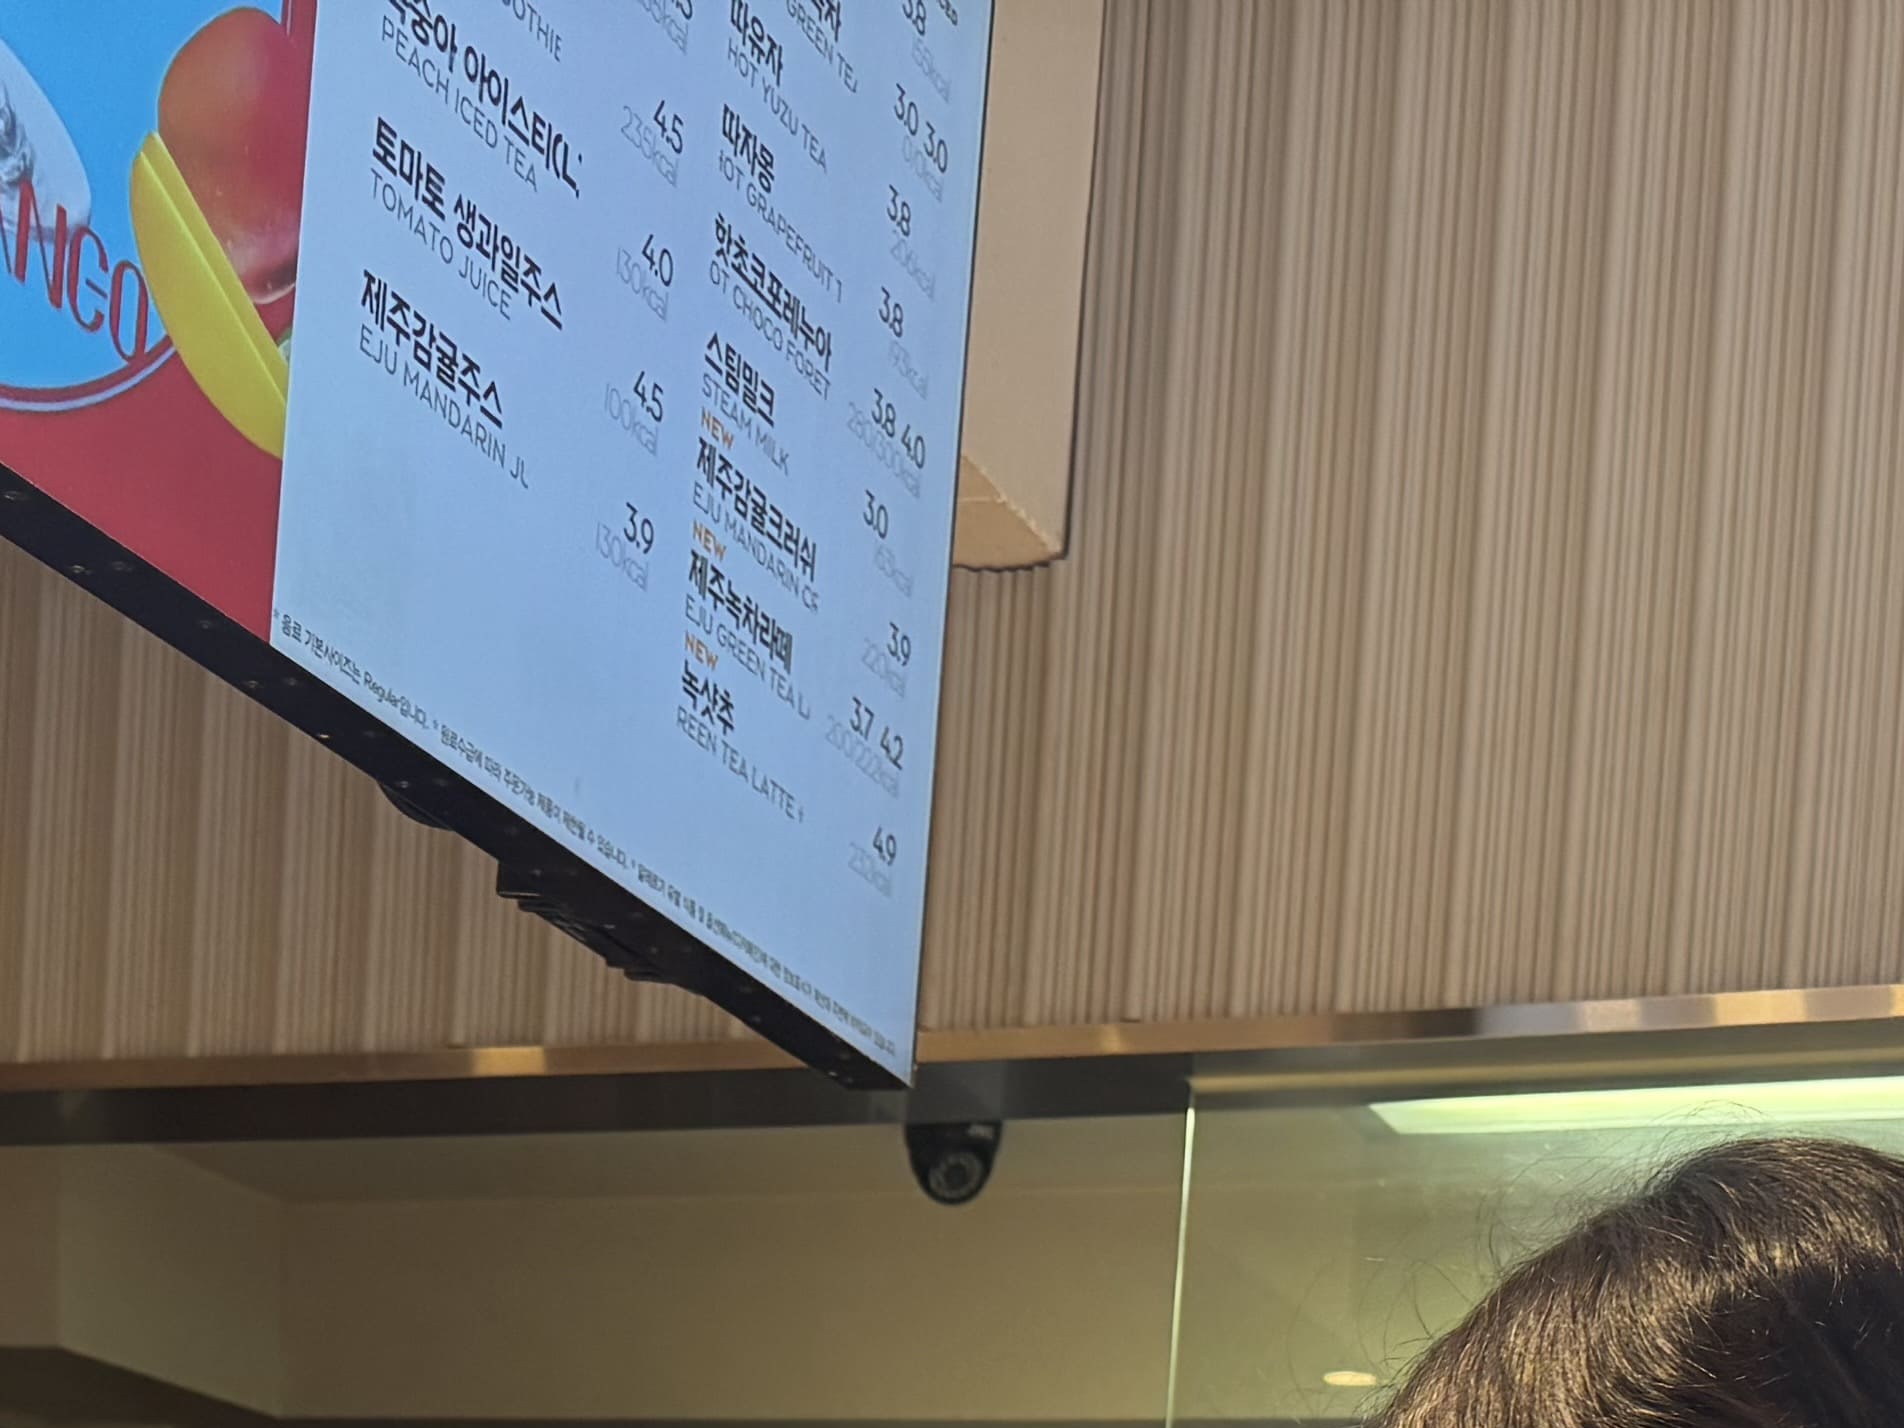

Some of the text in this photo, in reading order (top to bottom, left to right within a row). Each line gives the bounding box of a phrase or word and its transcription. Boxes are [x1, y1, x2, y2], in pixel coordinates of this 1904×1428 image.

[381, 14, 539, 193] PEACH ICED TEA
[652, 99, 685, 154] 4.5
[727, 37, 828, 173] HOT YUZU TEA
[894, 83, 949, 175] 3.0 3.0
[370, 167, 512, 320] TOMATO JUICE
[372, 116, 563, 330] 토마토 생과일주스
[641, 234, 674, 286] 4.0
[746, 182, 833, 293] GRAPEFRUIT
[360, 269, 504, 430] 제주감귤주스
[732, 284, 785, 352] CHOCO
[402, 360, 506, 468] MANDARIN
[633, 370, 664, 423] 4.5
[701, 372, 790, 477] STEAM MILK
[704, 331, 776, 429] 스팀밀크
[701, 405, 736, 451] NEW
[900, 423, 927, 470] 4.0
[623, 501, 654, 554] 3.9
[693, 518, 729, 563] NEW
[696, 435, 818, 584] 제주감귤크러쉬
[683, 629, 721, 673] NEW
[688, 547, 794, 676] 제주녹차라떼
[716, 621, 767, 684] GREEN
[769, 665, 797, 713] TEA
[720, 739, 750, 786] TEA
[750, 765, 797, 822] LATTE
[871, 825, 898, 878] 4.9
